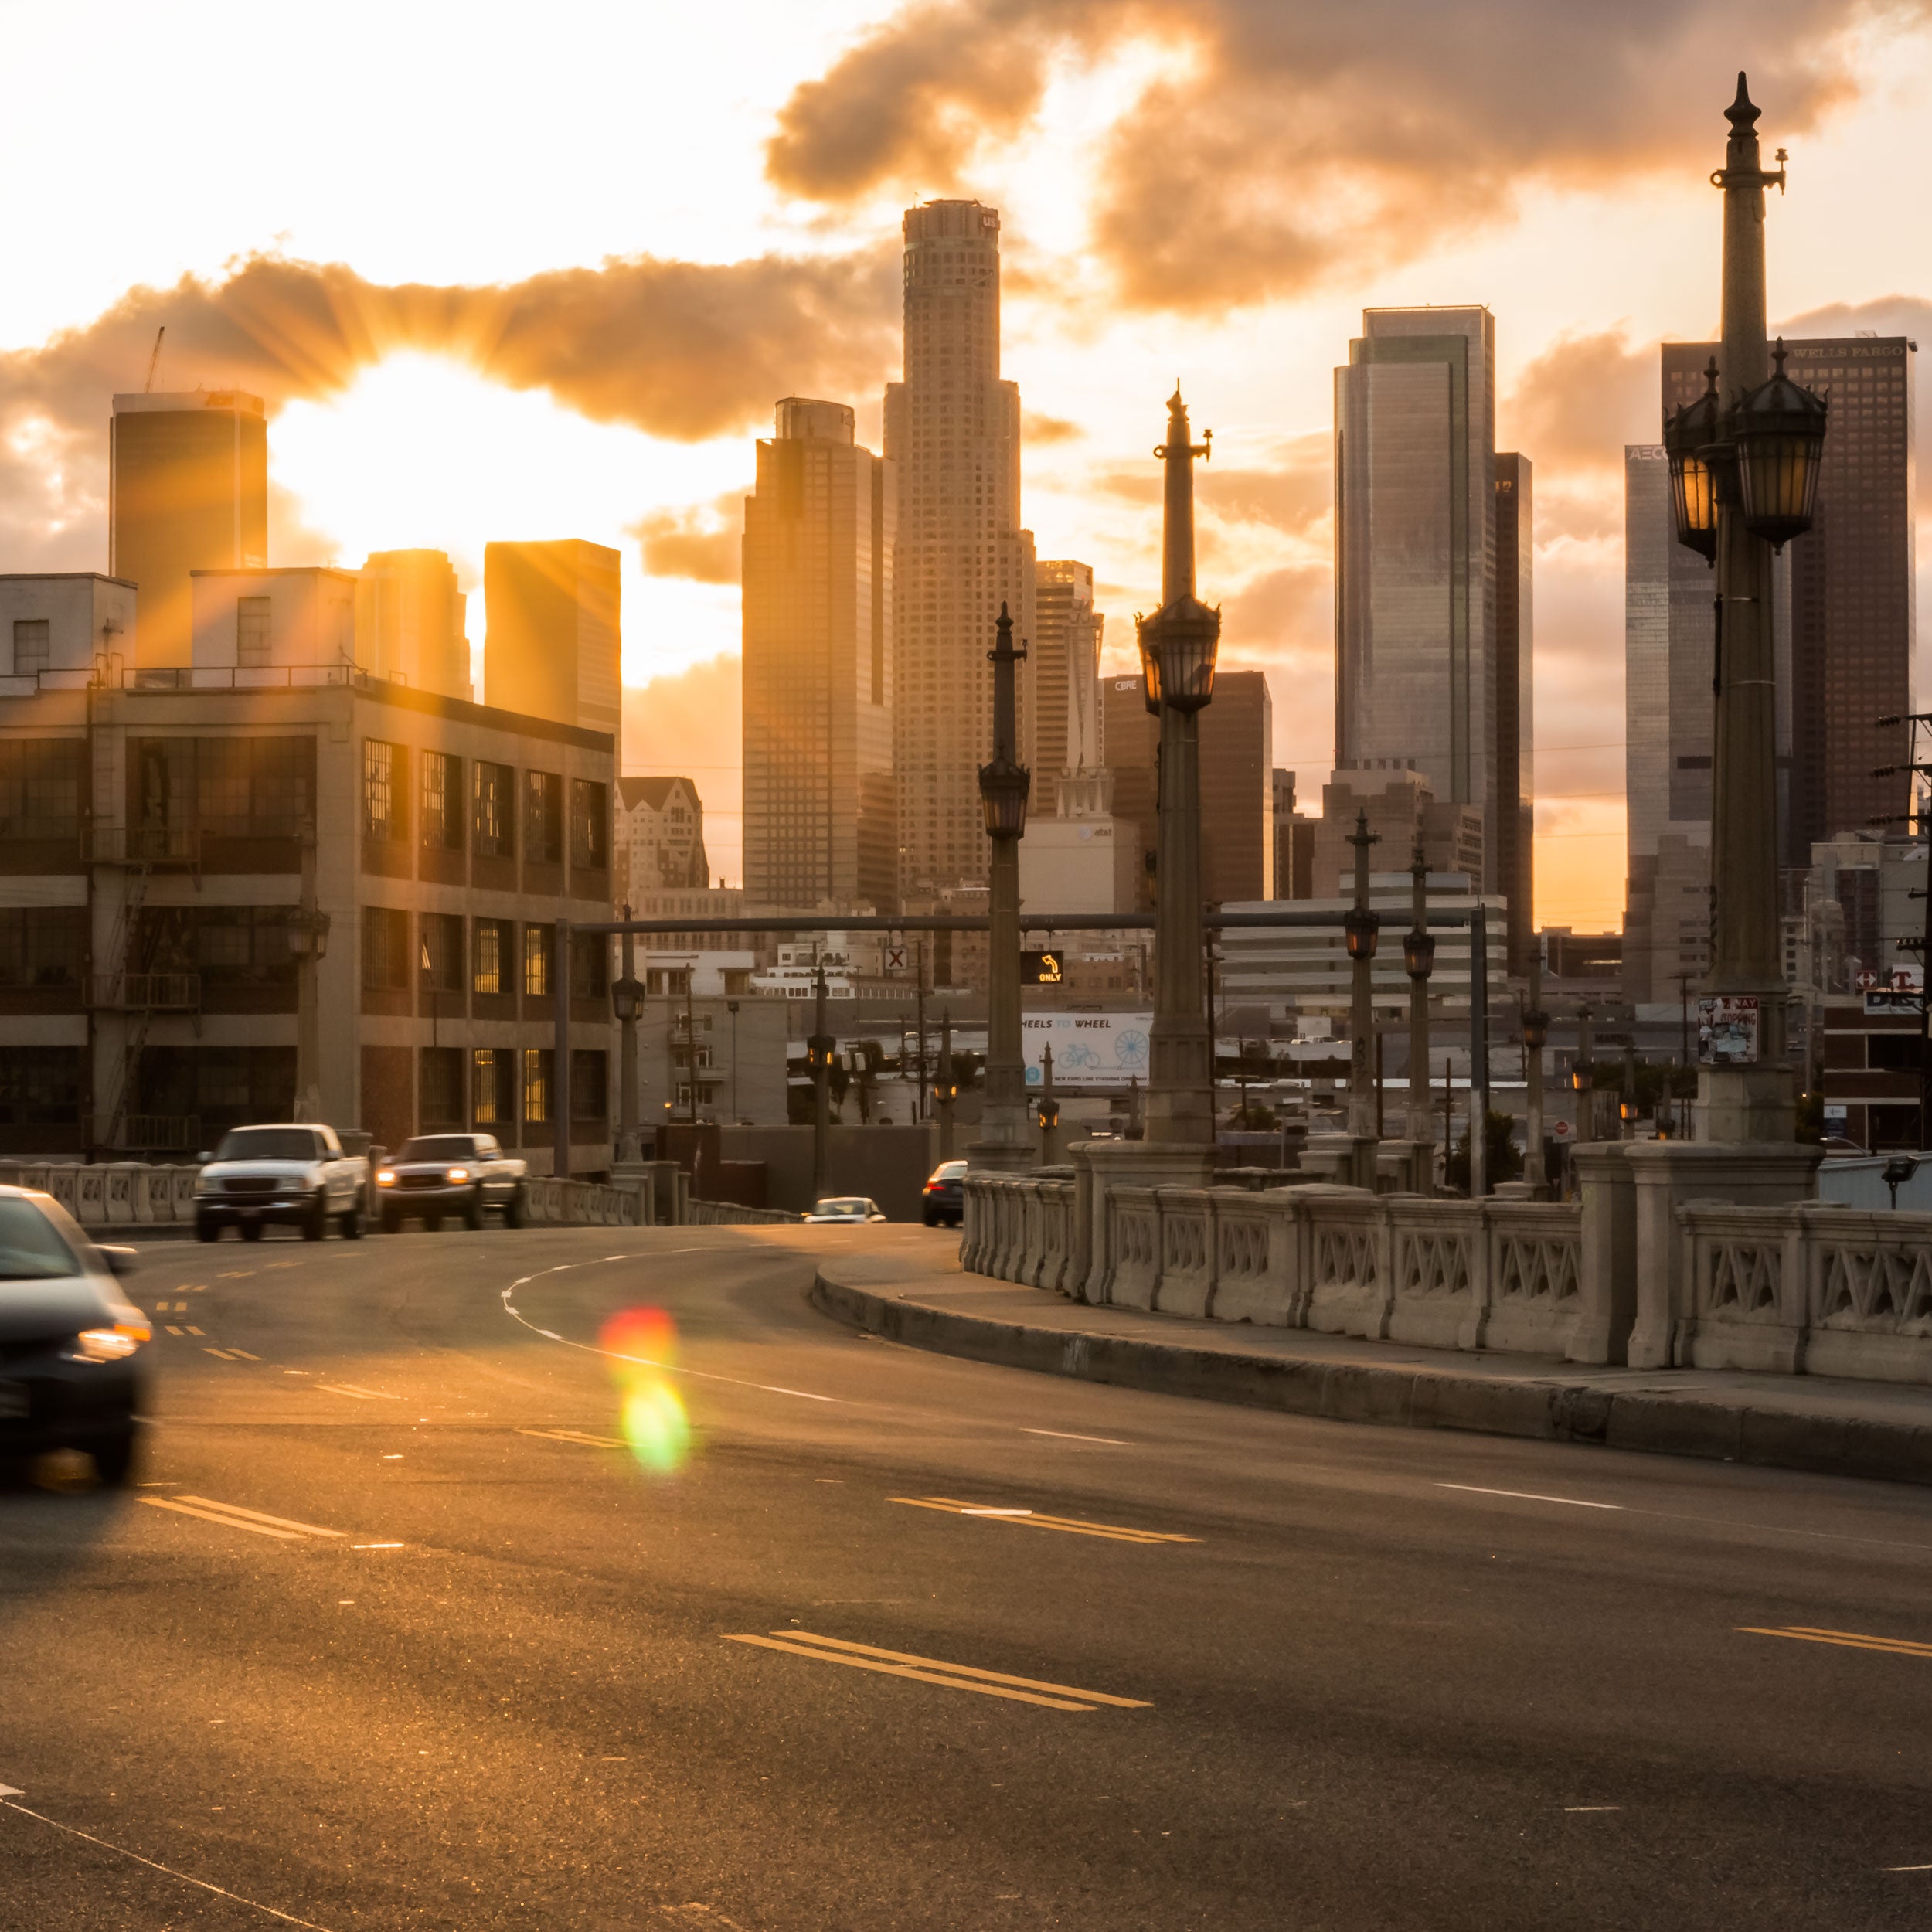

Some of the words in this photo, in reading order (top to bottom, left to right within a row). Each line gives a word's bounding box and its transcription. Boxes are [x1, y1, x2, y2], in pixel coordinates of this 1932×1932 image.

[1794, 347, 1848, 359] WELLS
[1852, 345, 1903, 358] FARGO
[1114, 679, 1138, 692] CBRE
[1039, 973, 1062, 982] ONLY
